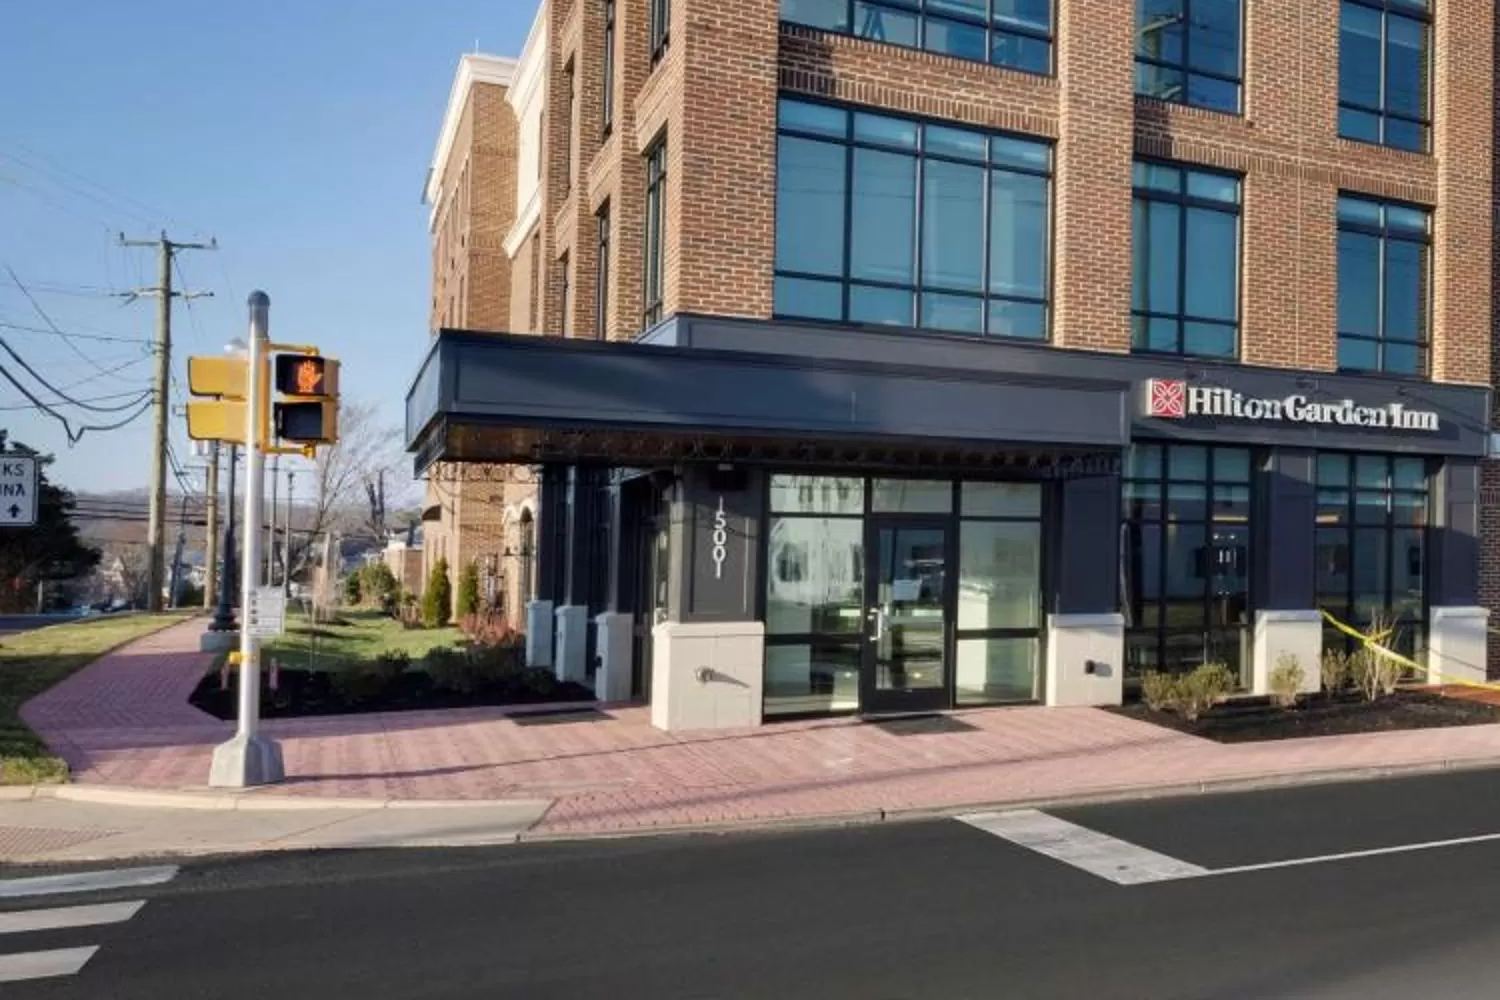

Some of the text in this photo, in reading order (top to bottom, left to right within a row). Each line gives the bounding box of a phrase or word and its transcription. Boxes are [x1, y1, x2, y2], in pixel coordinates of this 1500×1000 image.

[1188, 387, 1440, 431] Hilton Garden Inn
[712, 495, 727, 579] 15001
